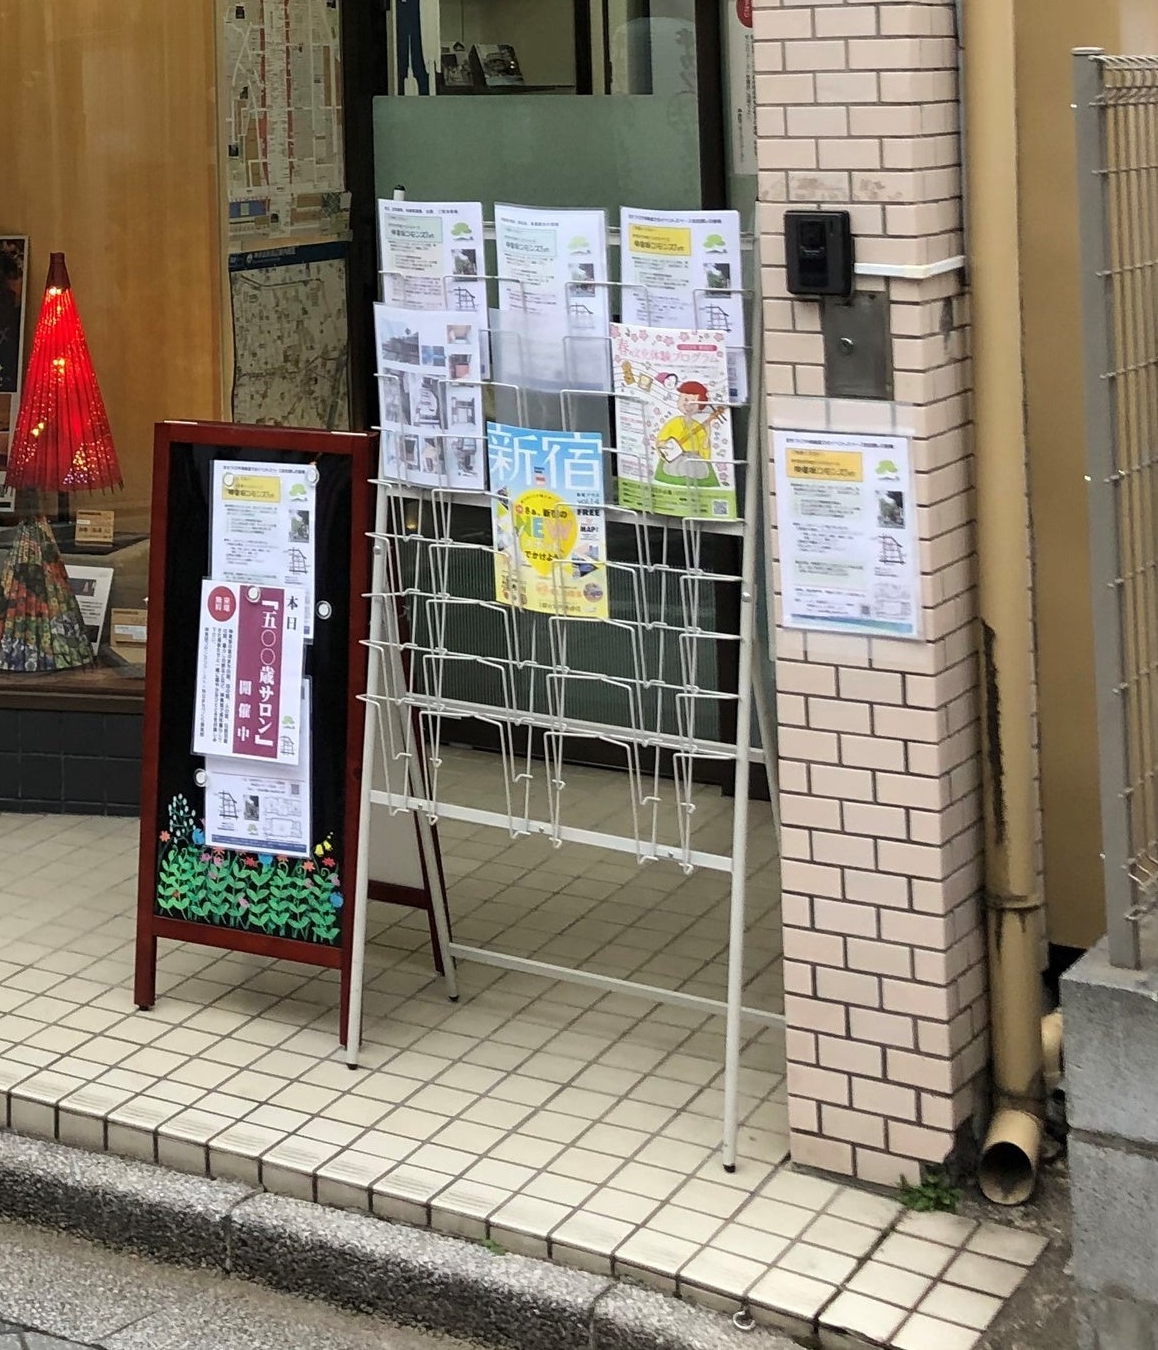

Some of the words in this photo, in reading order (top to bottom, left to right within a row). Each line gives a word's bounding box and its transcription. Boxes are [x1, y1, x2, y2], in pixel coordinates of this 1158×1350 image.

[487, 423, 603, 491] 新宿
[515, 514, 573, 542] NEW
[576, 508, 601, 518] FREE
[286, 595, 299, 631] 本日
[237, 679, 252, 742] 開催中
